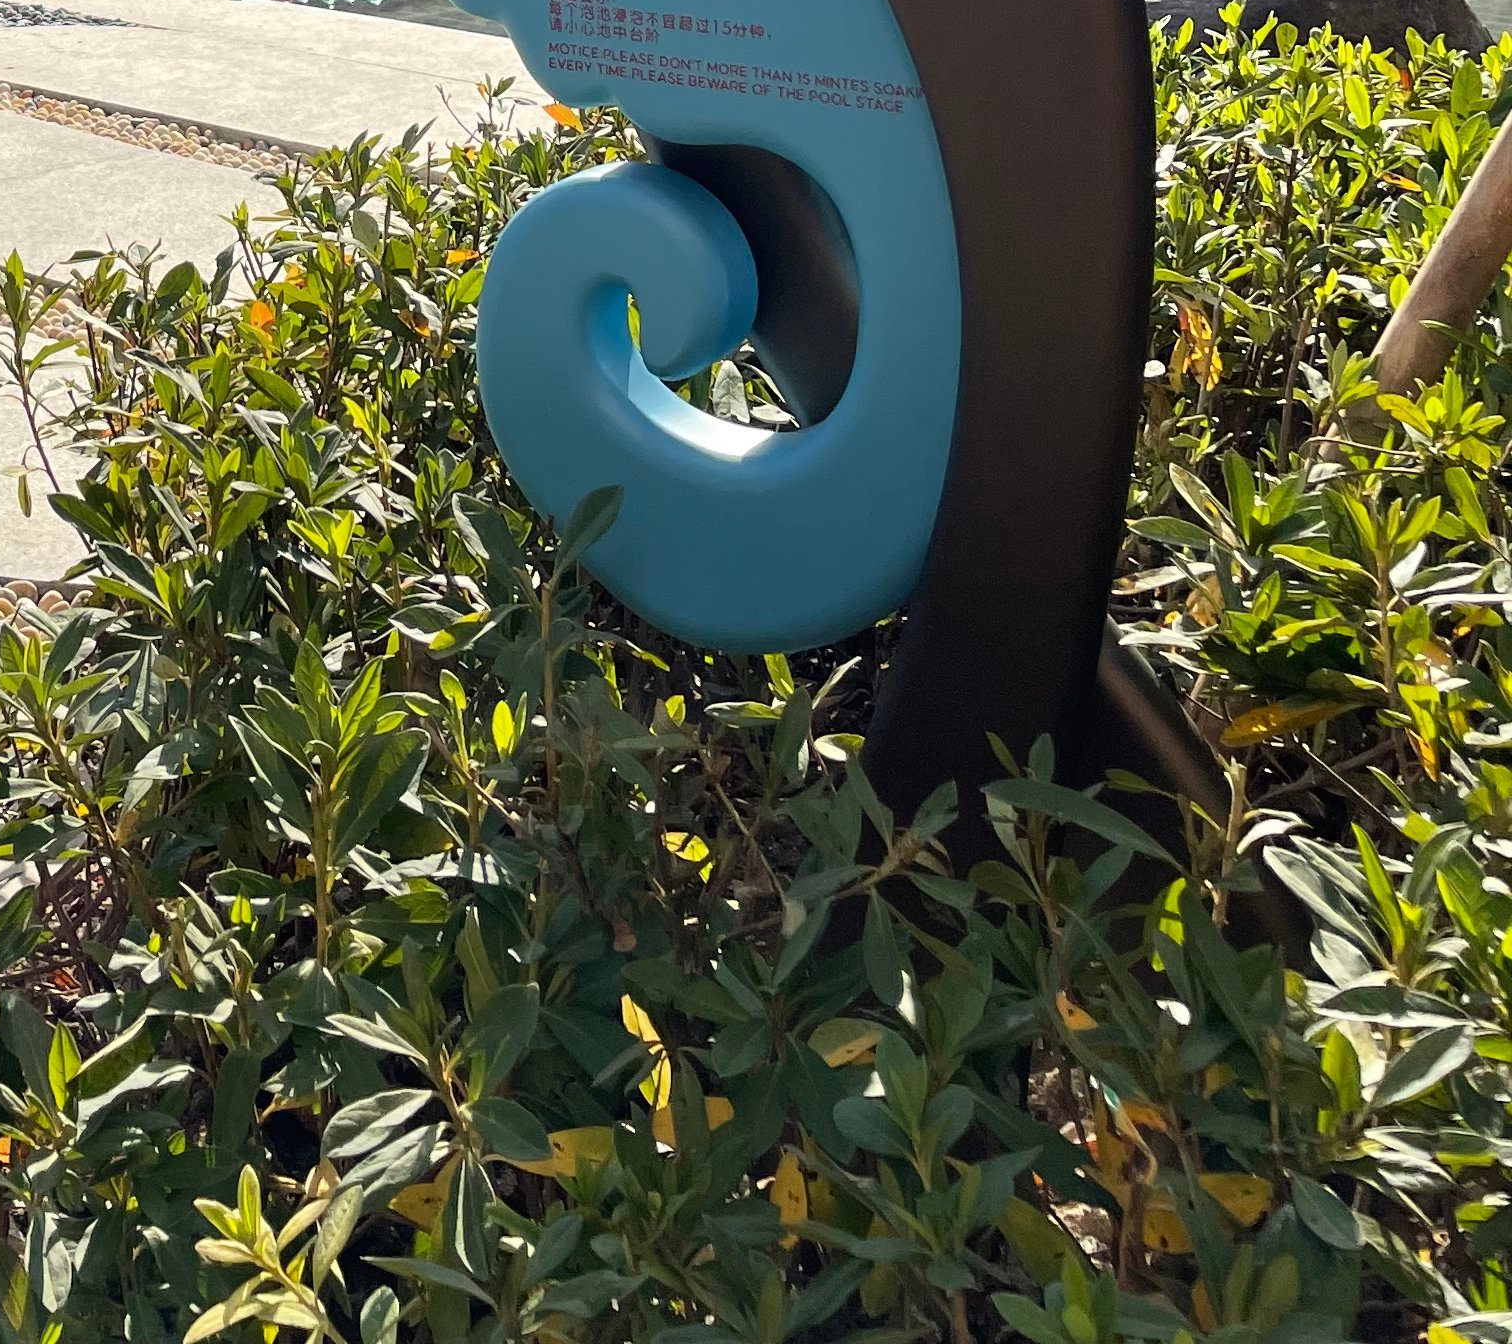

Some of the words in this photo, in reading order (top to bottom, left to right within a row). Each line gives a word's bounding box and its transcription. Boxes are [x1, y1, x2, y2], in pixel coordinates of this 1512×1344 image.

[548, 57, 592, 73] EVERY
[688, 74, 747, 94] BEWARE
[752, 83, 770, 97] OF
[777, 86, 804, 101] THE
[809, 90, 851, 108] POOL
[659, 55, 702, 71] DON'T
[707, 62, 747, 79] MORE
[752, 66, 792, 83] THAN
[796, 72, 810, 85] 15
